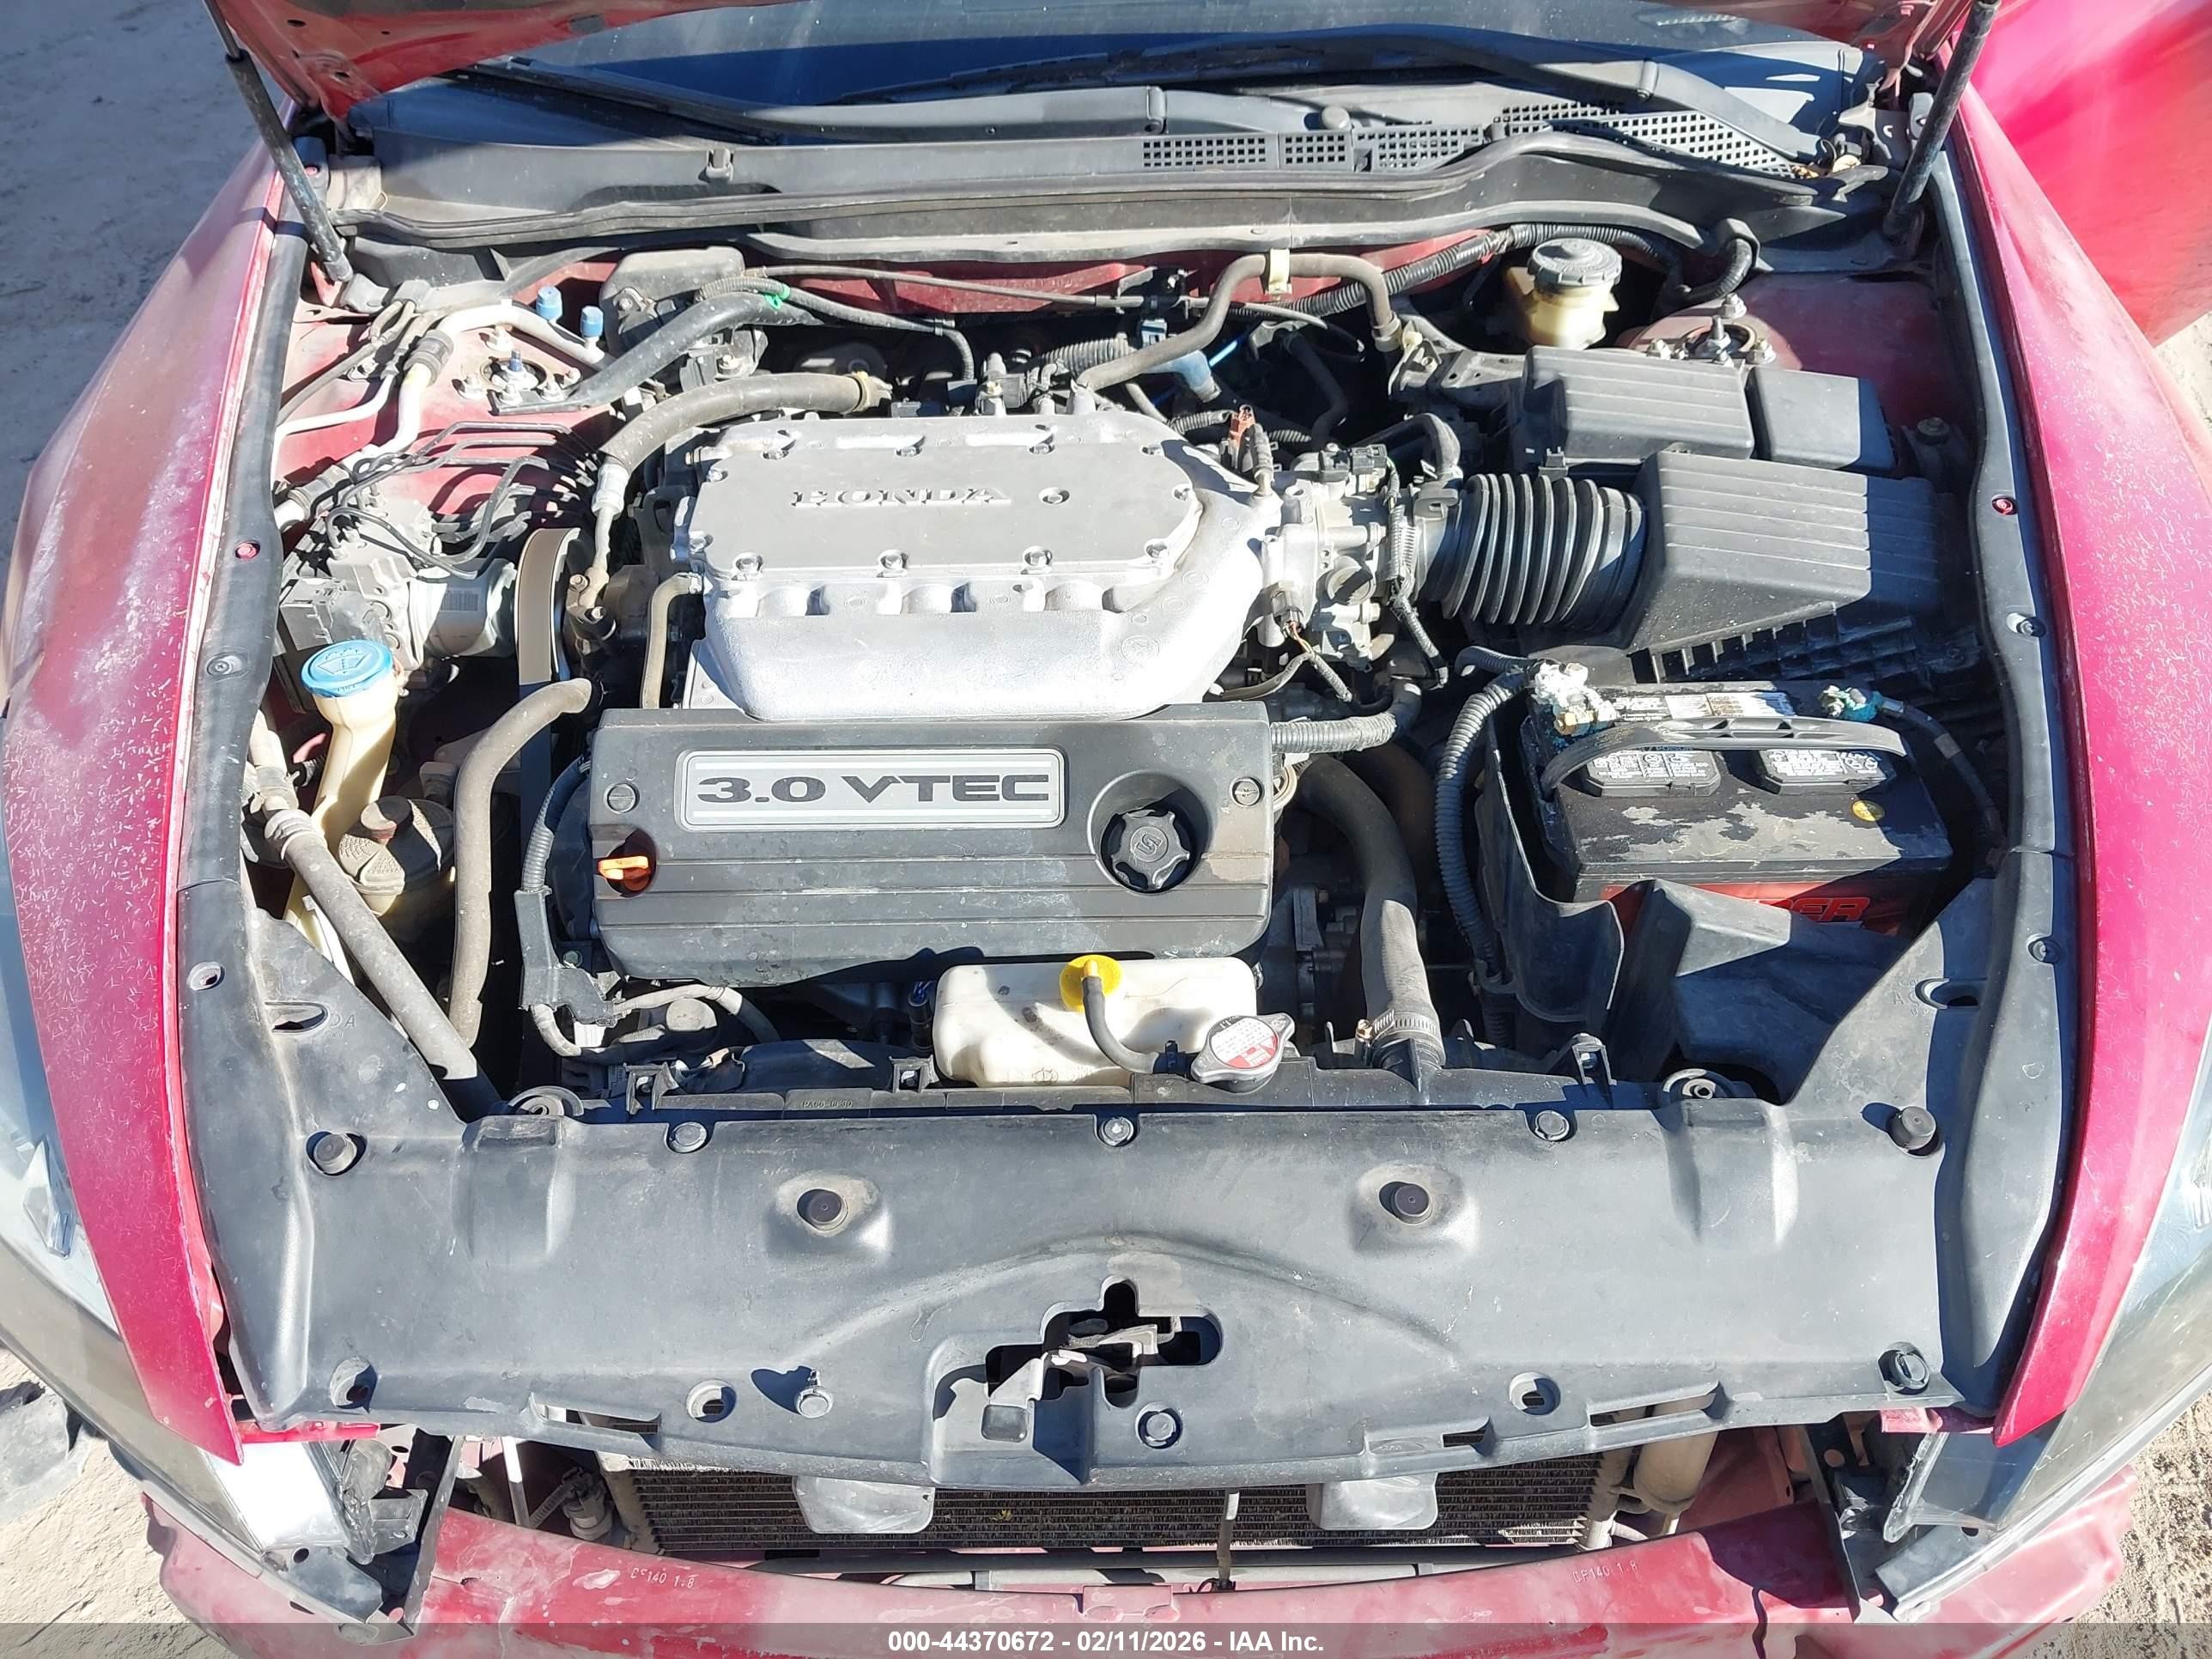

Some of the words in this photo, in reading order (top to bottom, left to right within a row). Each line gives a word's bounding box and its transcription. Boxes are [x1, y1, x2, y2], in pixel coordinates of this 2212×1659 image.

[790, 488, 1012, 507] HONDA
[697, 776, 826, 803] 3.0
[842, 775, 1049, 804] VTEC
